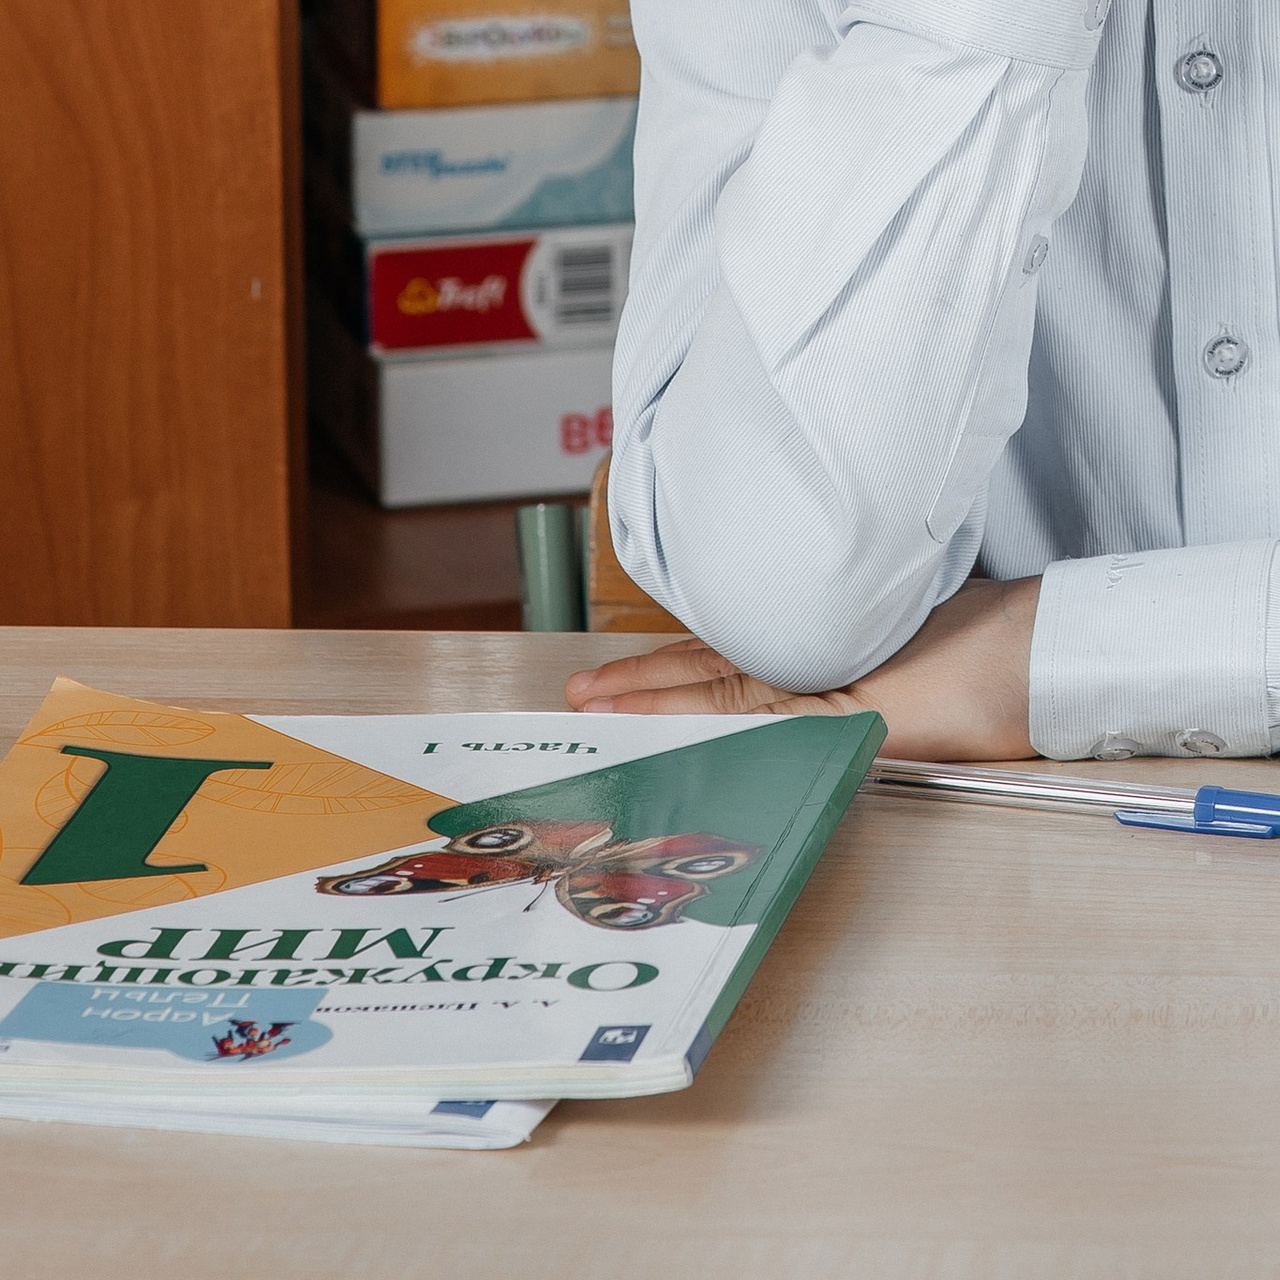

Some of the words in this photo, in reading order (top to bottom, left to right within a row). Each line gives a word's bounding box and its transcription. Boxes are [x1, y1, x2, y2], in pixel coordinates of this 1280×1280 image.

[420, 741, 447, 757] 1
[460, 741, 600, 757] Часть
[17, 745, 275, 887] 1
[95, 926, 456, 963] МИР
[90, 987, 250, 1010] Пельц
[80, 1004, 236, 1028] Аарон
